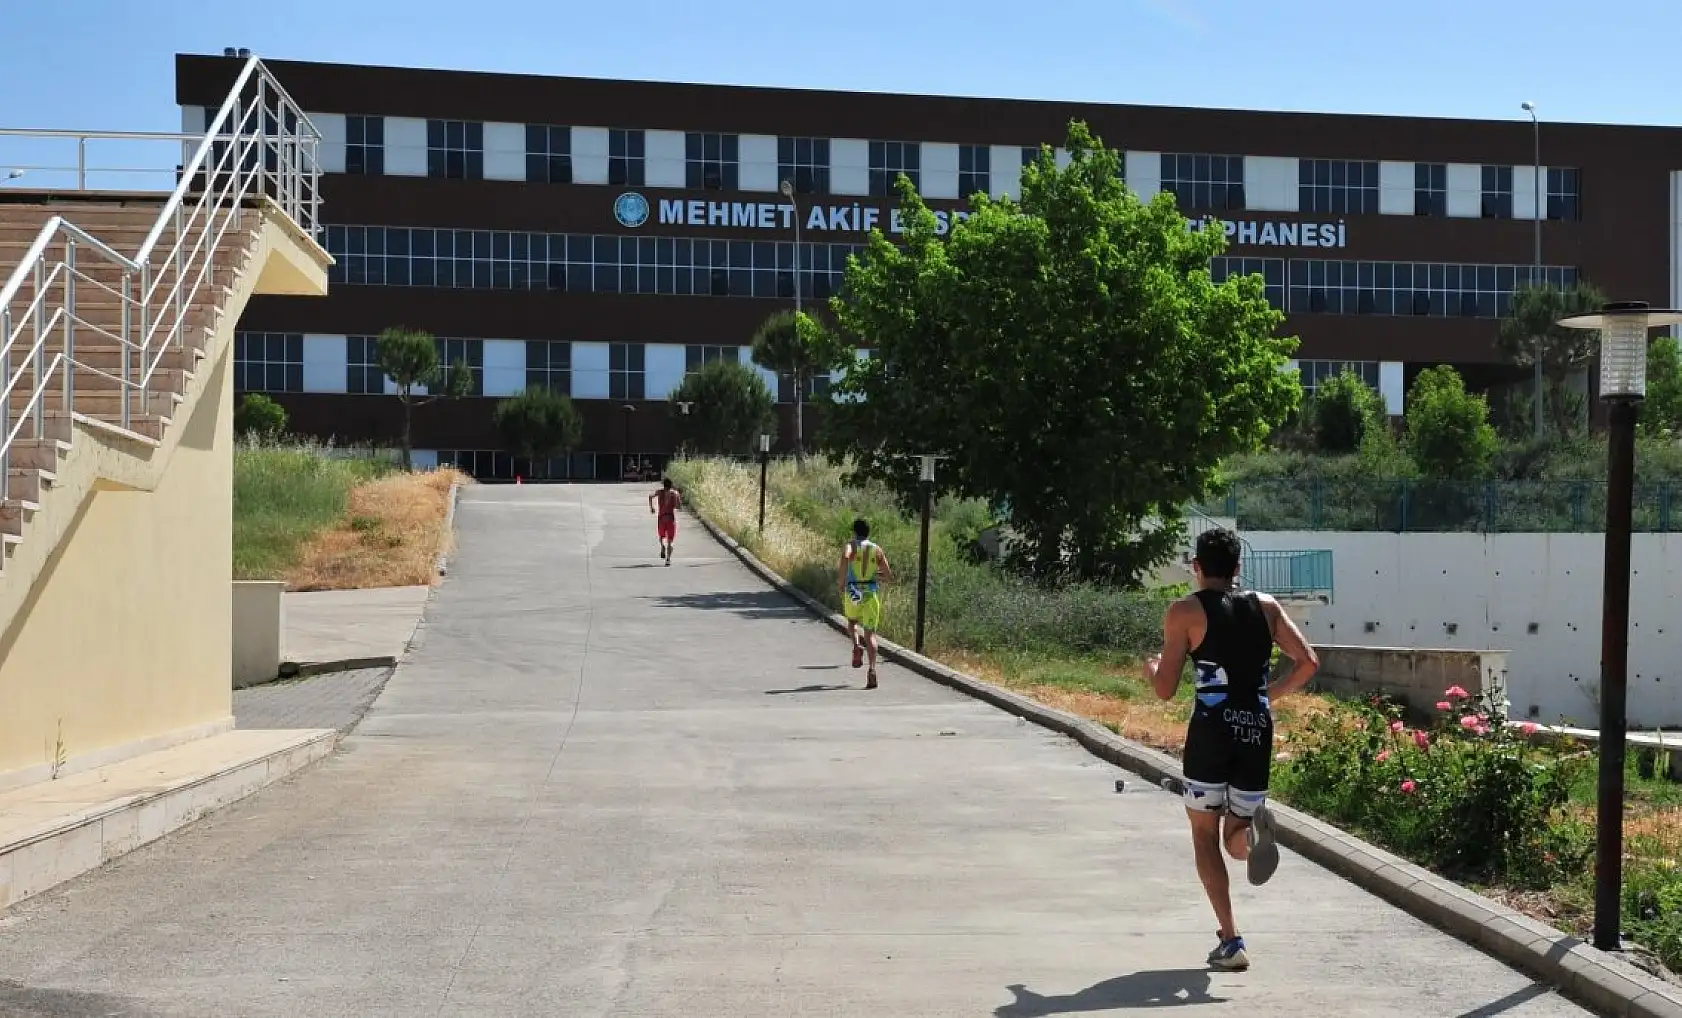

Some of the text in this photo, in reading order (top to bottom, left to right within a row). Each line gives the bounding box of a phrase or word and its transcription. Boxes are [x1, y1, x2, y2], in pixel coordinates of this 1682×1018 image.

[659, 199, 795, 229] MEHMET
[806, 202, 880, 231] AKİF
[1230, 725, 1261, 746] TUR
